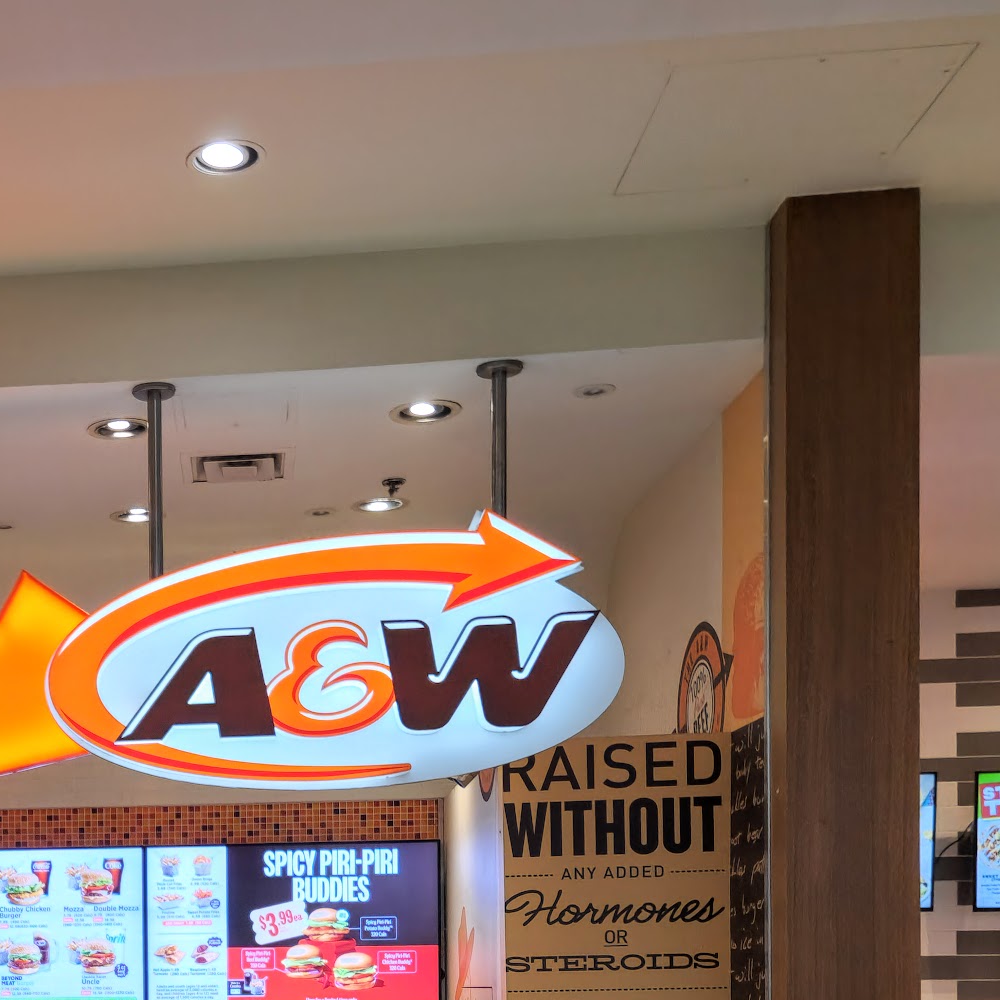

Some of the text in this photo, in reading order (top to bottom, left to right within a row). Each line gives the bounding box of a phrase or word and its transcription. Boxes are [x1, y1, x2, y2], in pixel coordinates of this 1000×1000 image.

[115, 610, 601, 746] A&W
[502, 740, 722, 792] RAISED
[503, 795, 722, 858] WITHOUT
[263, 848, 399, 878] SPICY PIRI-PIRI
[561, 865, 665, 880] ANY ADDED
[292, 876, 370, 903] BUDDIES
[0, 905, 51, 914] Chubby Chicken
[0, 912, 22, 920] Burger
[505, 889, 725, 927] Hormones
[604, 930, 628, 944] OR
[505, 952, 720, 972] STEROIDS
